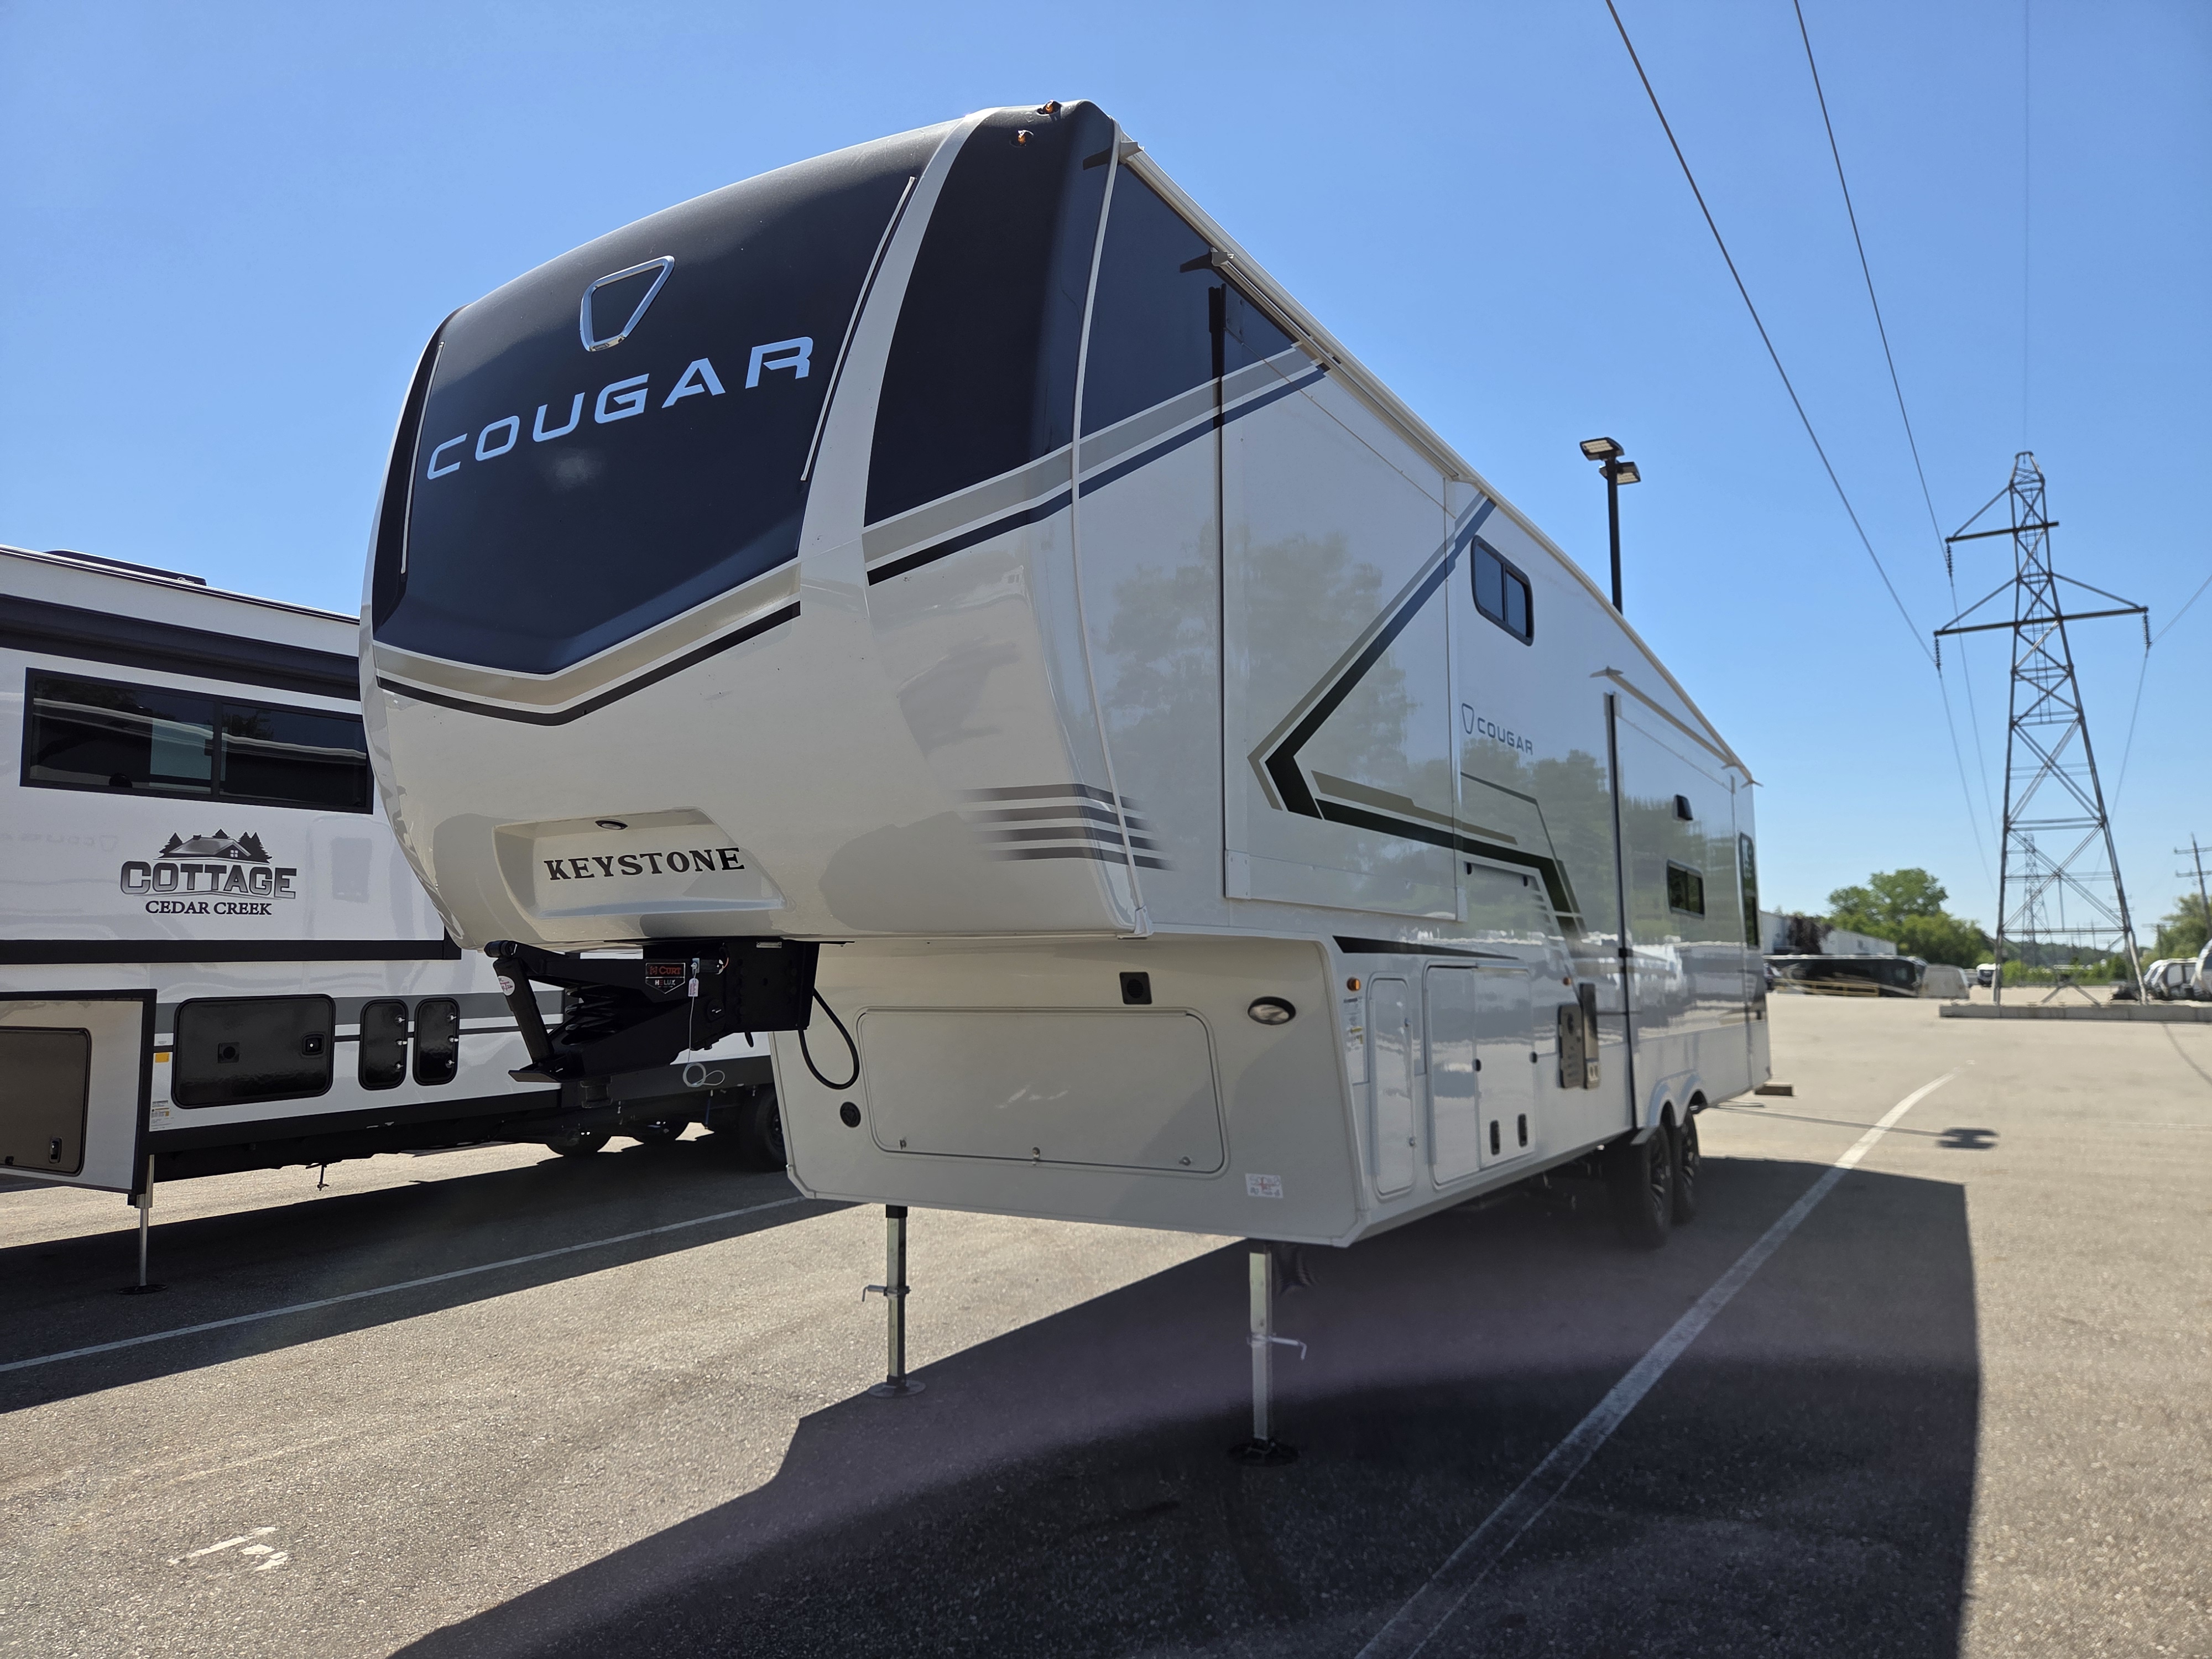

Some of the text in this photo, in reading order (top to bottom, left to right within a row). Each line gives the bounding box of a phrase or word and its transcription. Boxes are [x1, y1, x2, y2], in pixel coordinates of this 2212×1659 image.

[427, 337, 813, 479] COUGAR
[1478, 717, 1533, 755] COUGAR
[121, 860, 297, 899] COTTAGE
[544, 847, 745, 880] KEYSTONE
[145, 900, 272, 915] CEDAR CREEK
